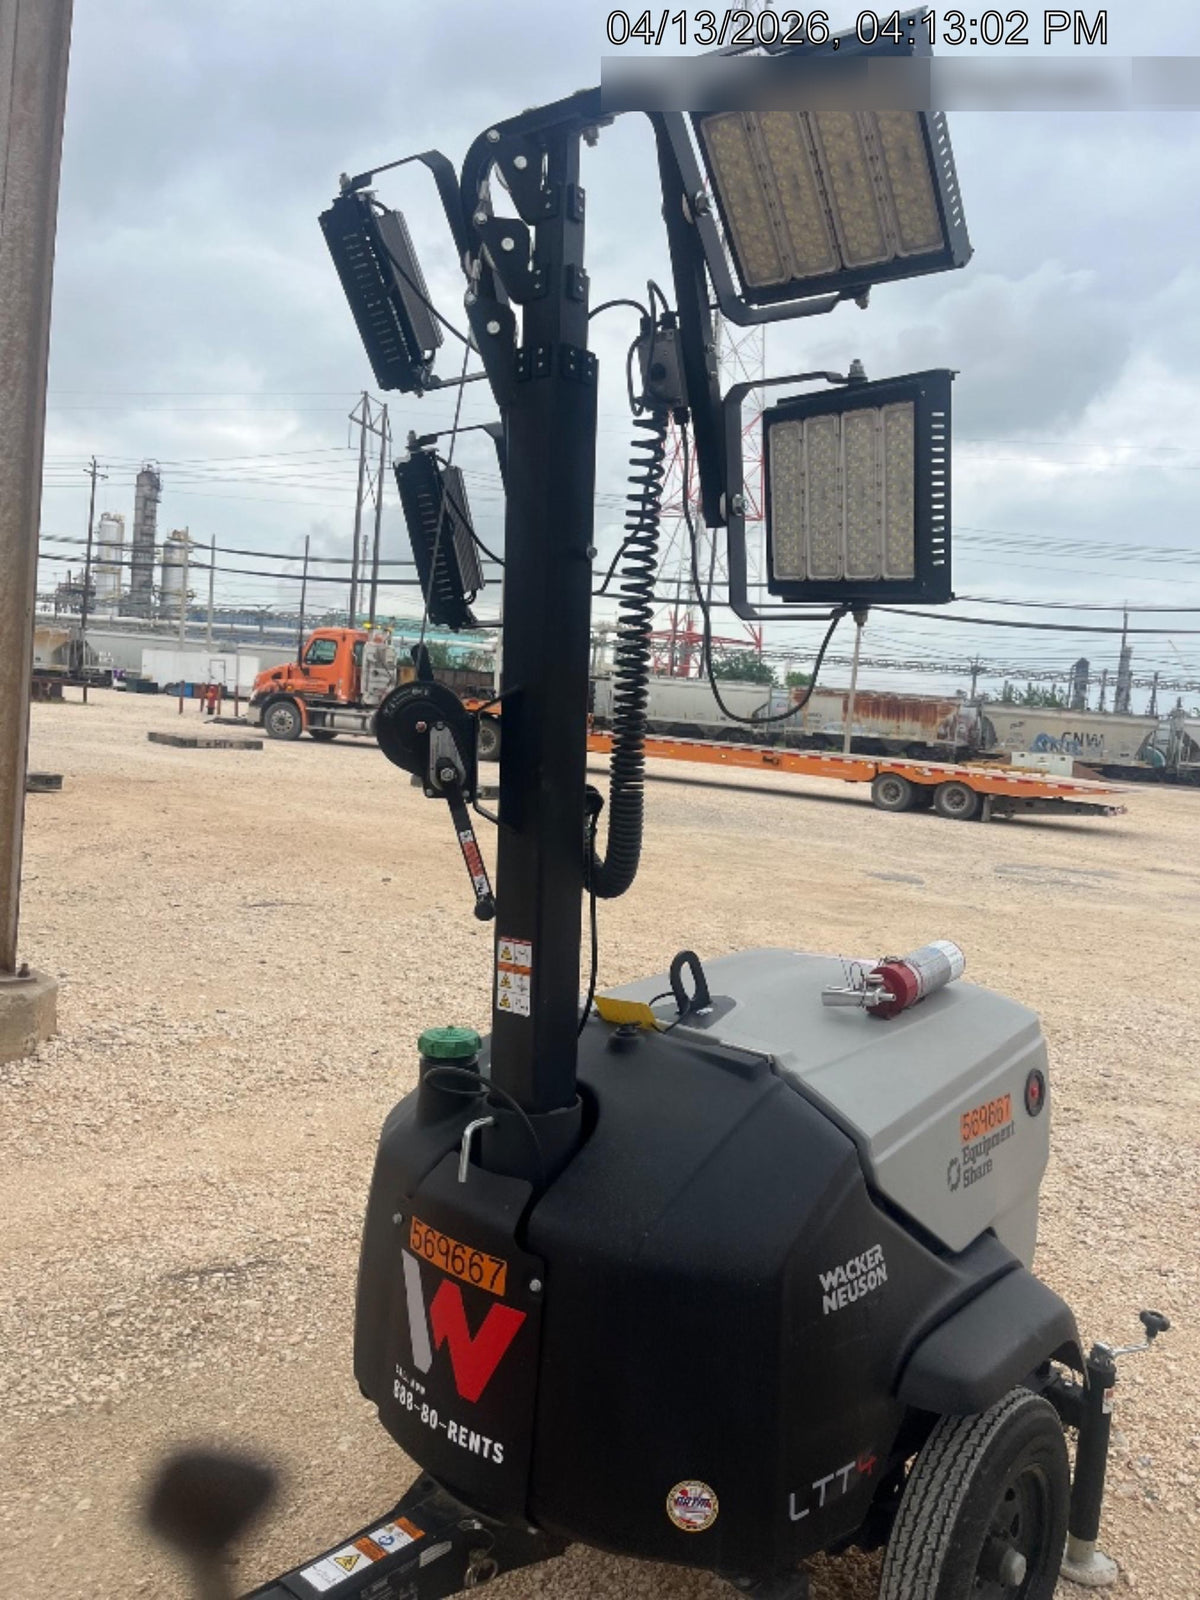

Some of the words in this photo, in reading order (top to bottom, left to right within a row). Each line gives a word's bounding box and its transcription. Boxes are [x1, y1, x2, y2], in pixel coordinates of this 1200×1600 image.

[962, 1094, 1011, 1141] 569667
[962, 1120, 1016, 1166] Equipment
[963, 1159, 993, 1189] Share
[411, 1219, 506, 1290] 569667
[818, 1243, 884, 1292] WACKER
[822, 1263, 888, 1315] NEUSON
[393, 1378, 505, 1465] 888-80-RENTS
